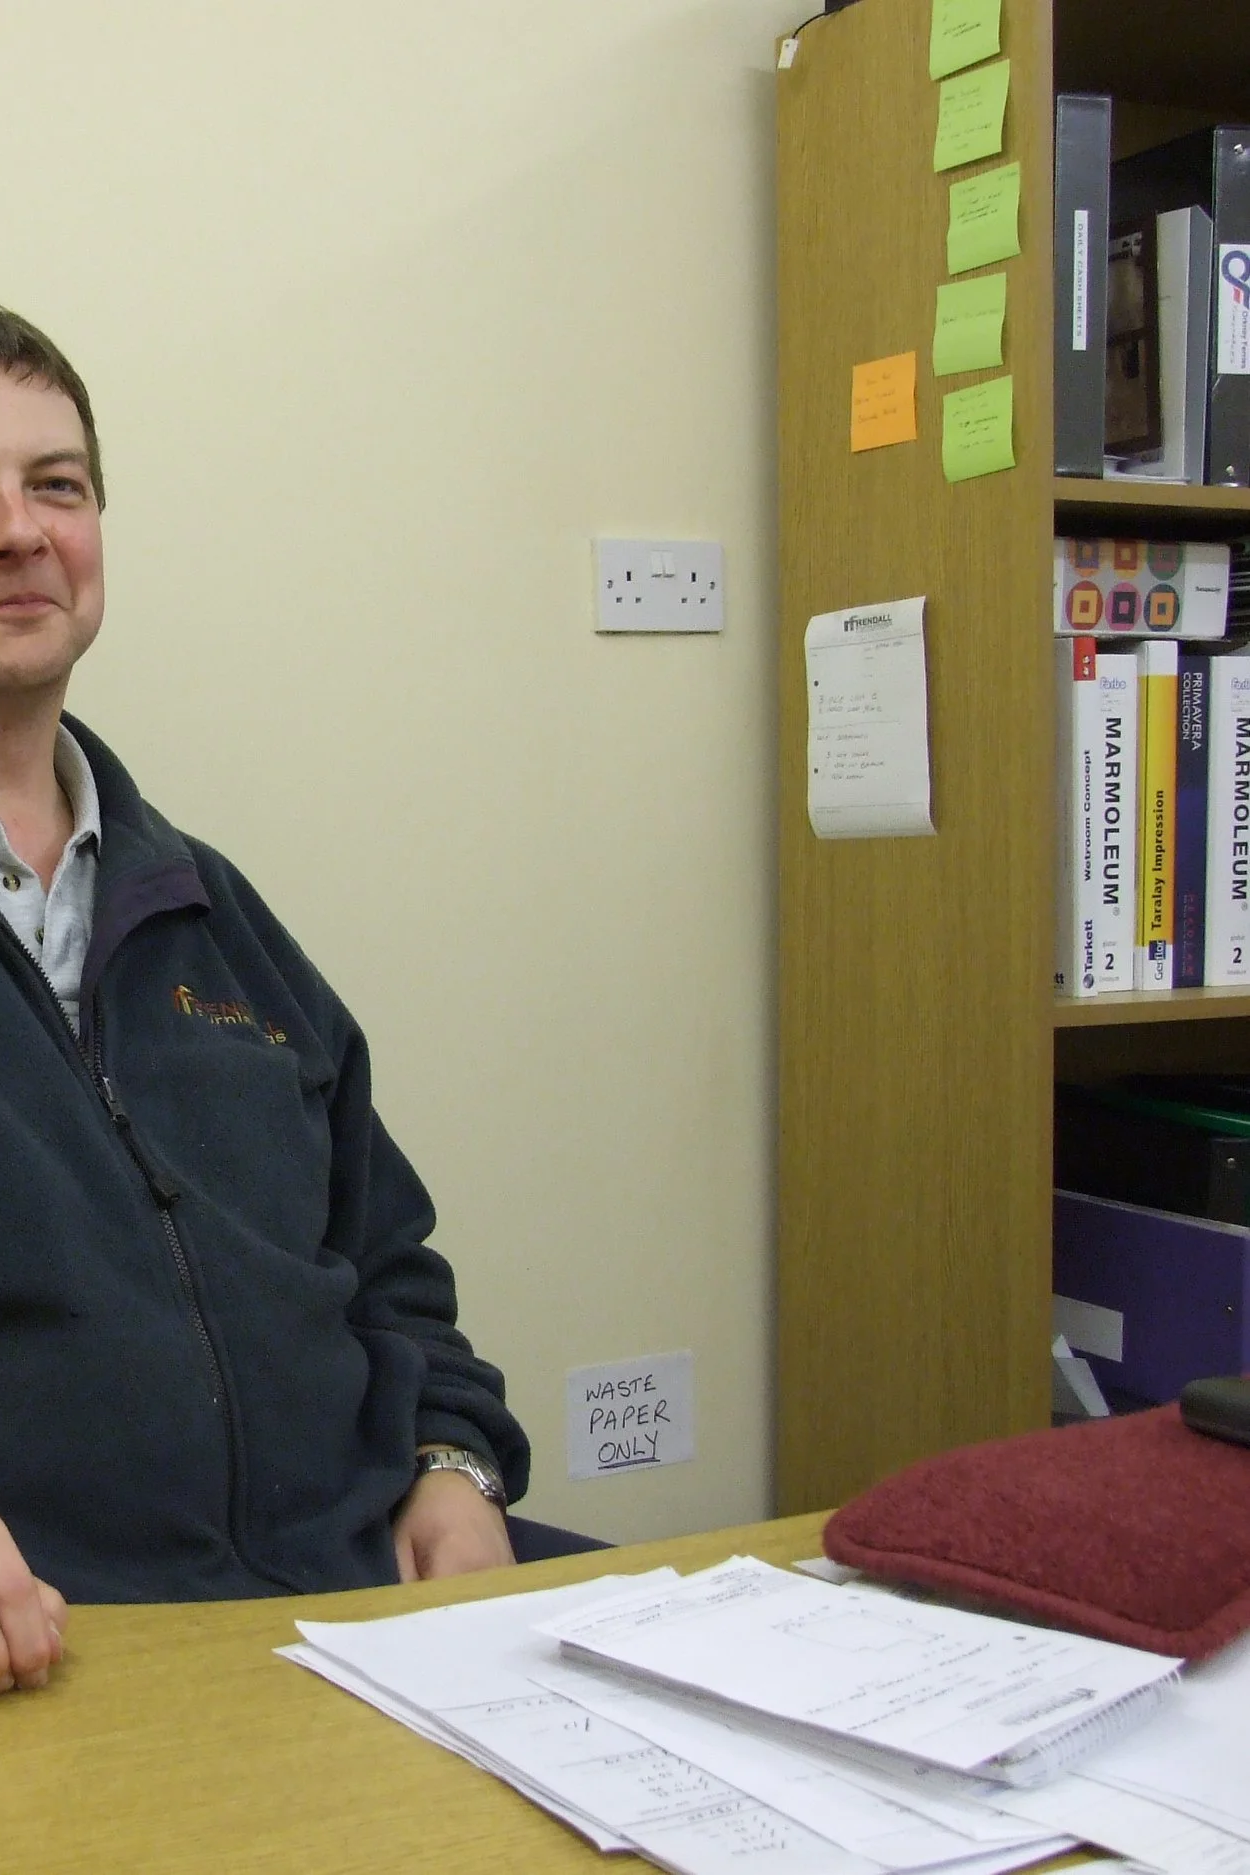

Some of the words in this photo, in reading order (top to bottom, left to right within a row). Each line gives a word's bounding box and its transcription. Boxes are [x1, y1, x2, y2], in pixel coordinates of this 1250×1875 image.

[1182, 671, 1191, 740] COLLECTION
[1191, 672, 1203, 751] PRIMAVERA
[1083, 749, 1093, 812] Concept
[1083, 817, 1092, 882] Wetroom
[1152, 790, 1166, 872] Impression
[1151, 877, 1165, 931] Taralay
[1083, 919, 1093, 972] Tarkett
[1105, 953, 1114, 970] 2
[1233, 947, 1242, 963] 2
[586, 1374, 656, 1402] WASTE
[590, 1400, 671, 1434] PAPER
[598, 1430, 659, 1463] ONLY
